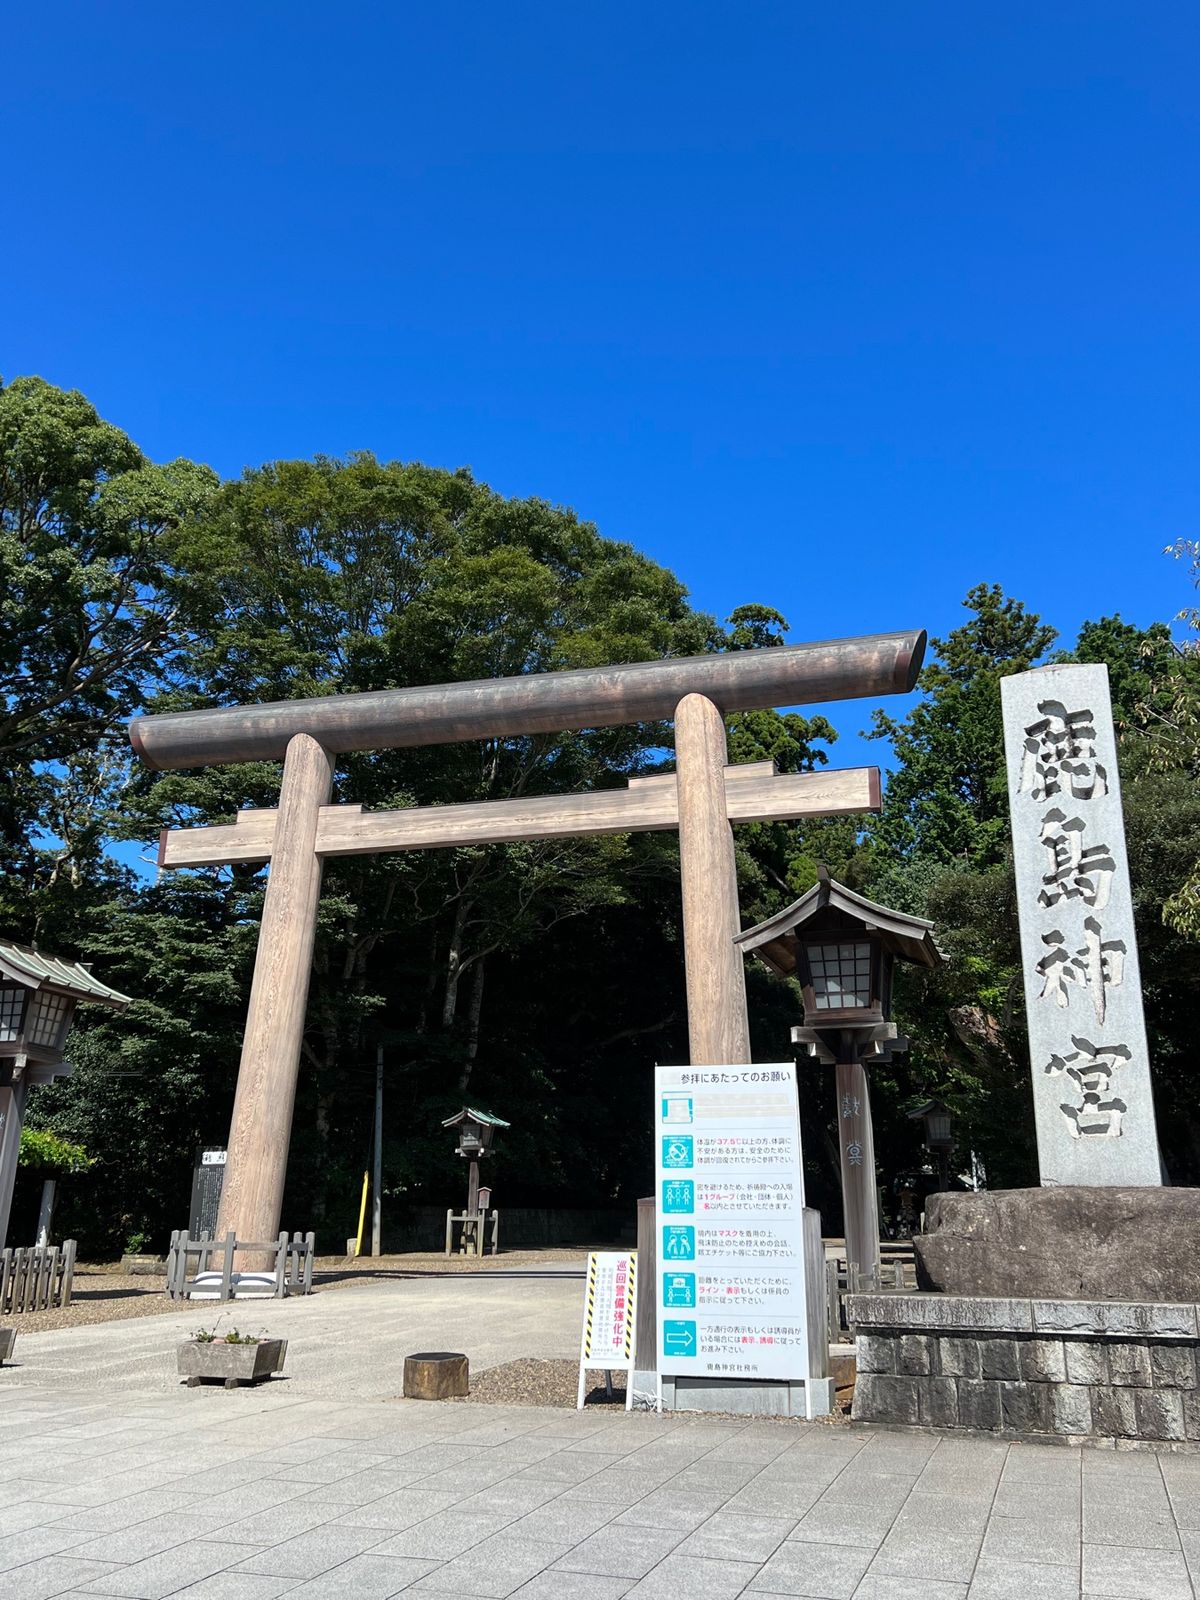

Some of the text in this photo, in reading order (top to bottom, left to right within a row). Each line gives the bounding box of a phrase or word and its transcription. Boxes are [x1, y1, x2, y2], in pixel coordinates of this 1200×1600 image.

[1017, 699, 1132, 1138] 鹿島神宮
[681, 1071, 791, 1084] 参拝にあたってのお願い
[612, 1260, 627, 1348] 巡回警備強化中
